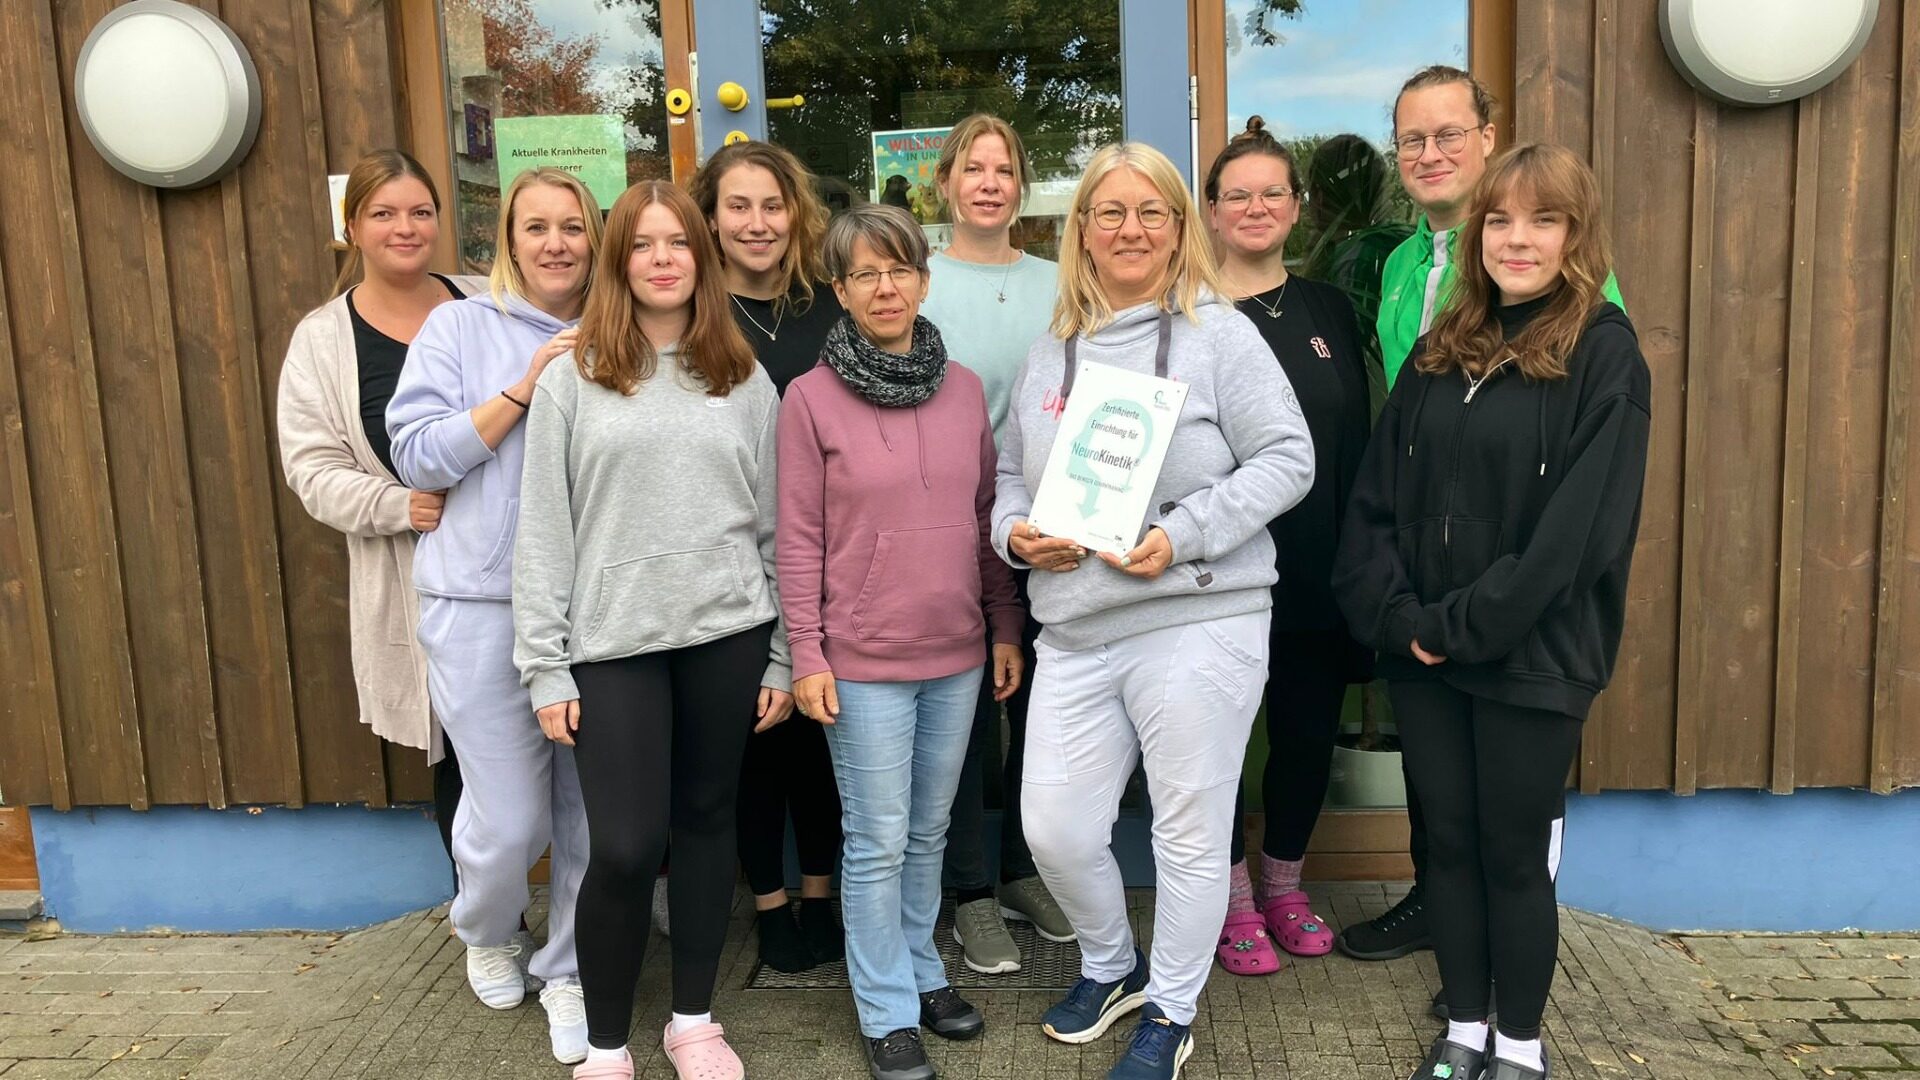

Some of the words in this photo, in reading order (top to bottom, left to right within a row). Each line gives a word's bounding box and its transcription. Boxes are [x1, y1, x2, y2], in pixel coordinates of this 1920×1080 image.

[888, 136, 946, 151] WILLKO
[511, 148, 549, 157] Aktuelle
[551, 146, 607, 156] Krankheiten
[906, 152, 918, 161] IN
[1102, 402, 1140, 420] Zertifizierte
[1090, 419, 1128, 439] Einrichtung
[1128, 430, 1139, 439] für
